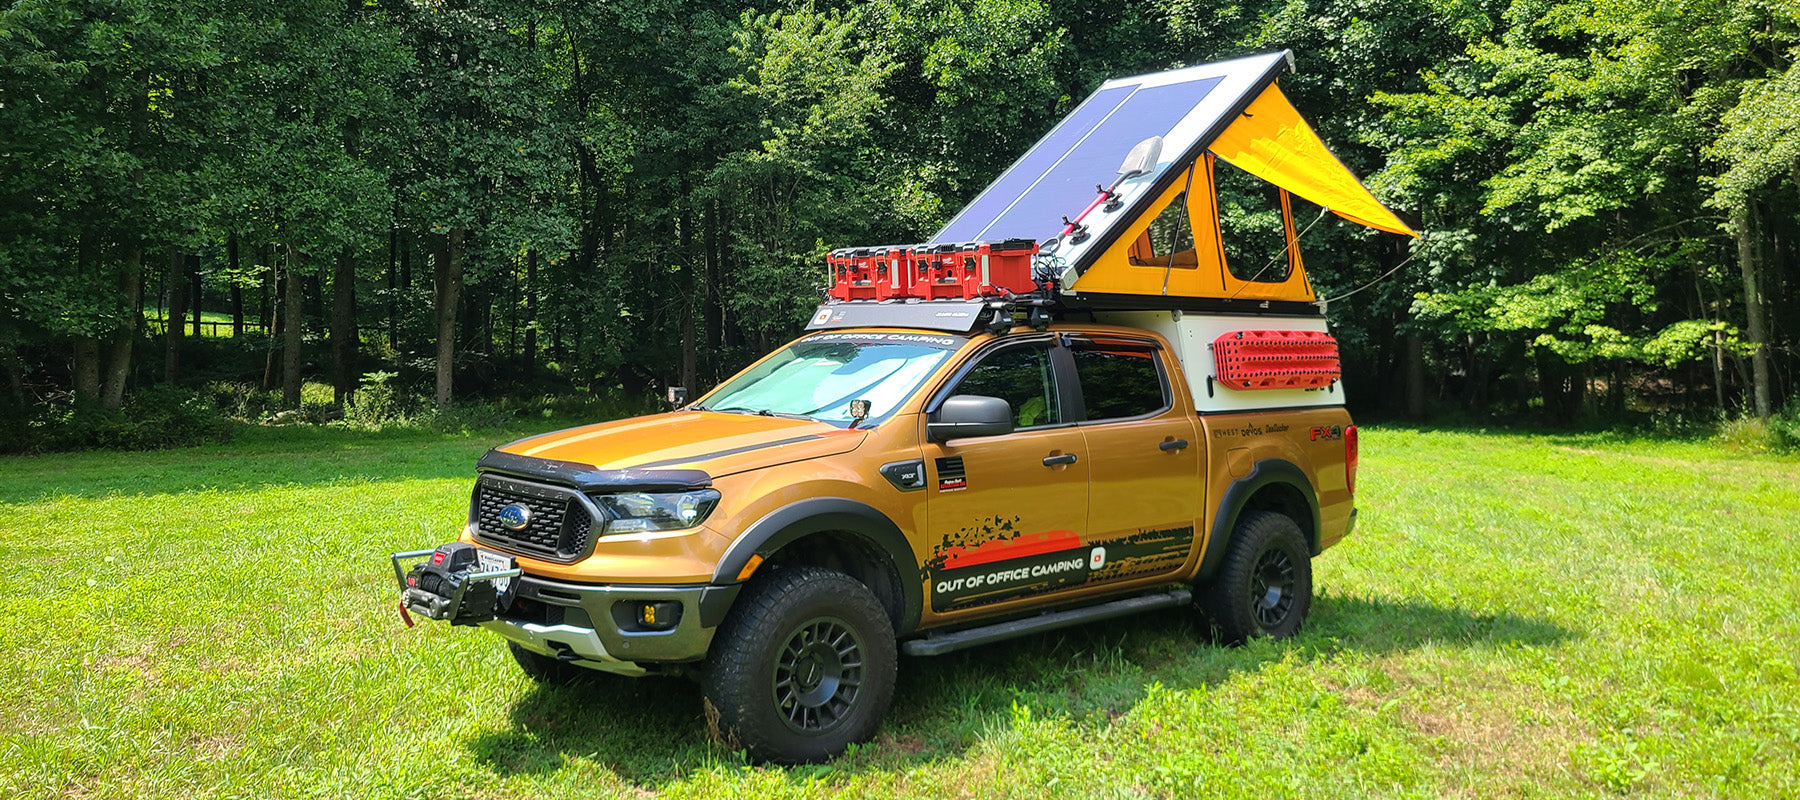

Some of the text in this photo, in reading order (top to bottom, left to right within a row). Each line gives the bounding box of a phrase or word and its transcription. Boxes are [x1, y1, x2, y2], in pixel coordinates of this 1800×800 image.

[801, 333, 955, 346] OUT OF OFFICE CAMPING
[1310, 425, 1342, 441] FX4
[936, 558, 1084, 593] OUT OF OFFICE CAMPING
